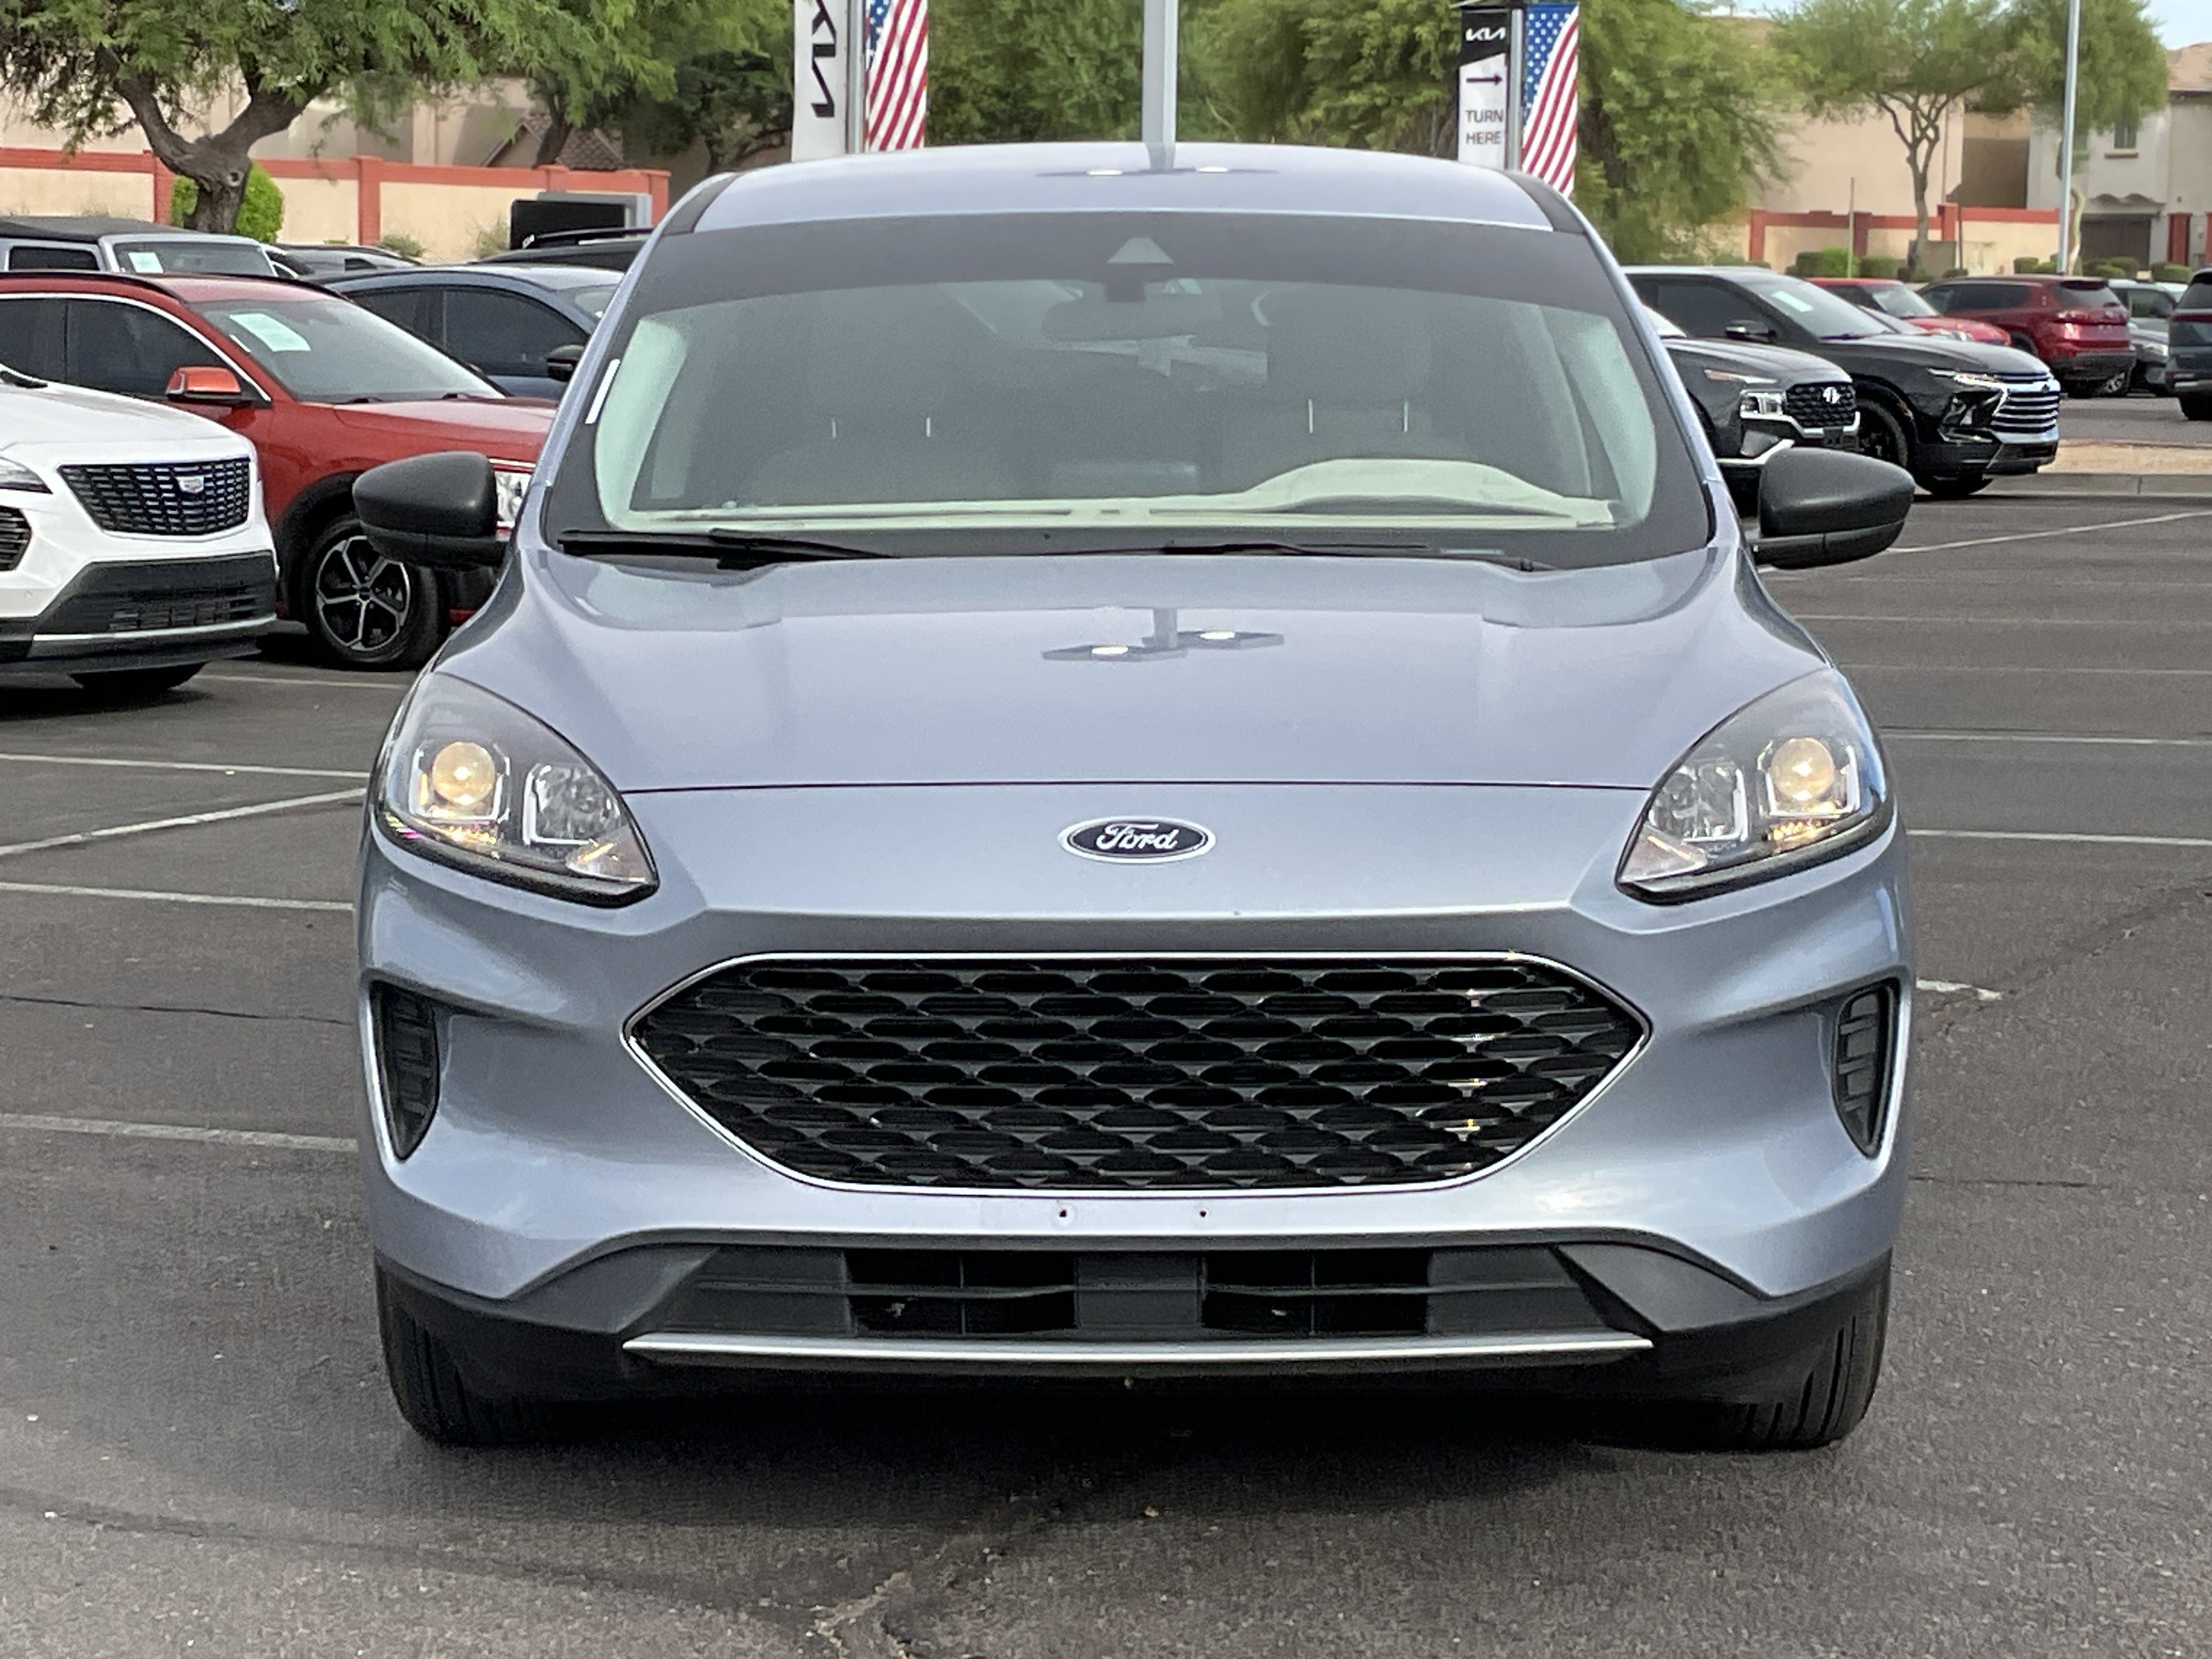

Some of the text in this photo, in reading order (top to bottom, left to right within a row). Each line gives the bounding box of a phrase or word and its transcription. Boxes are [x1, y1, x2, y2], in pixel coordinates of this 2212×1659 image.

[1465, 109, 1504, 123] TURN
[1465, 131, 1502, 145] HERE
[1096, 823, 1179, 850] Ford
